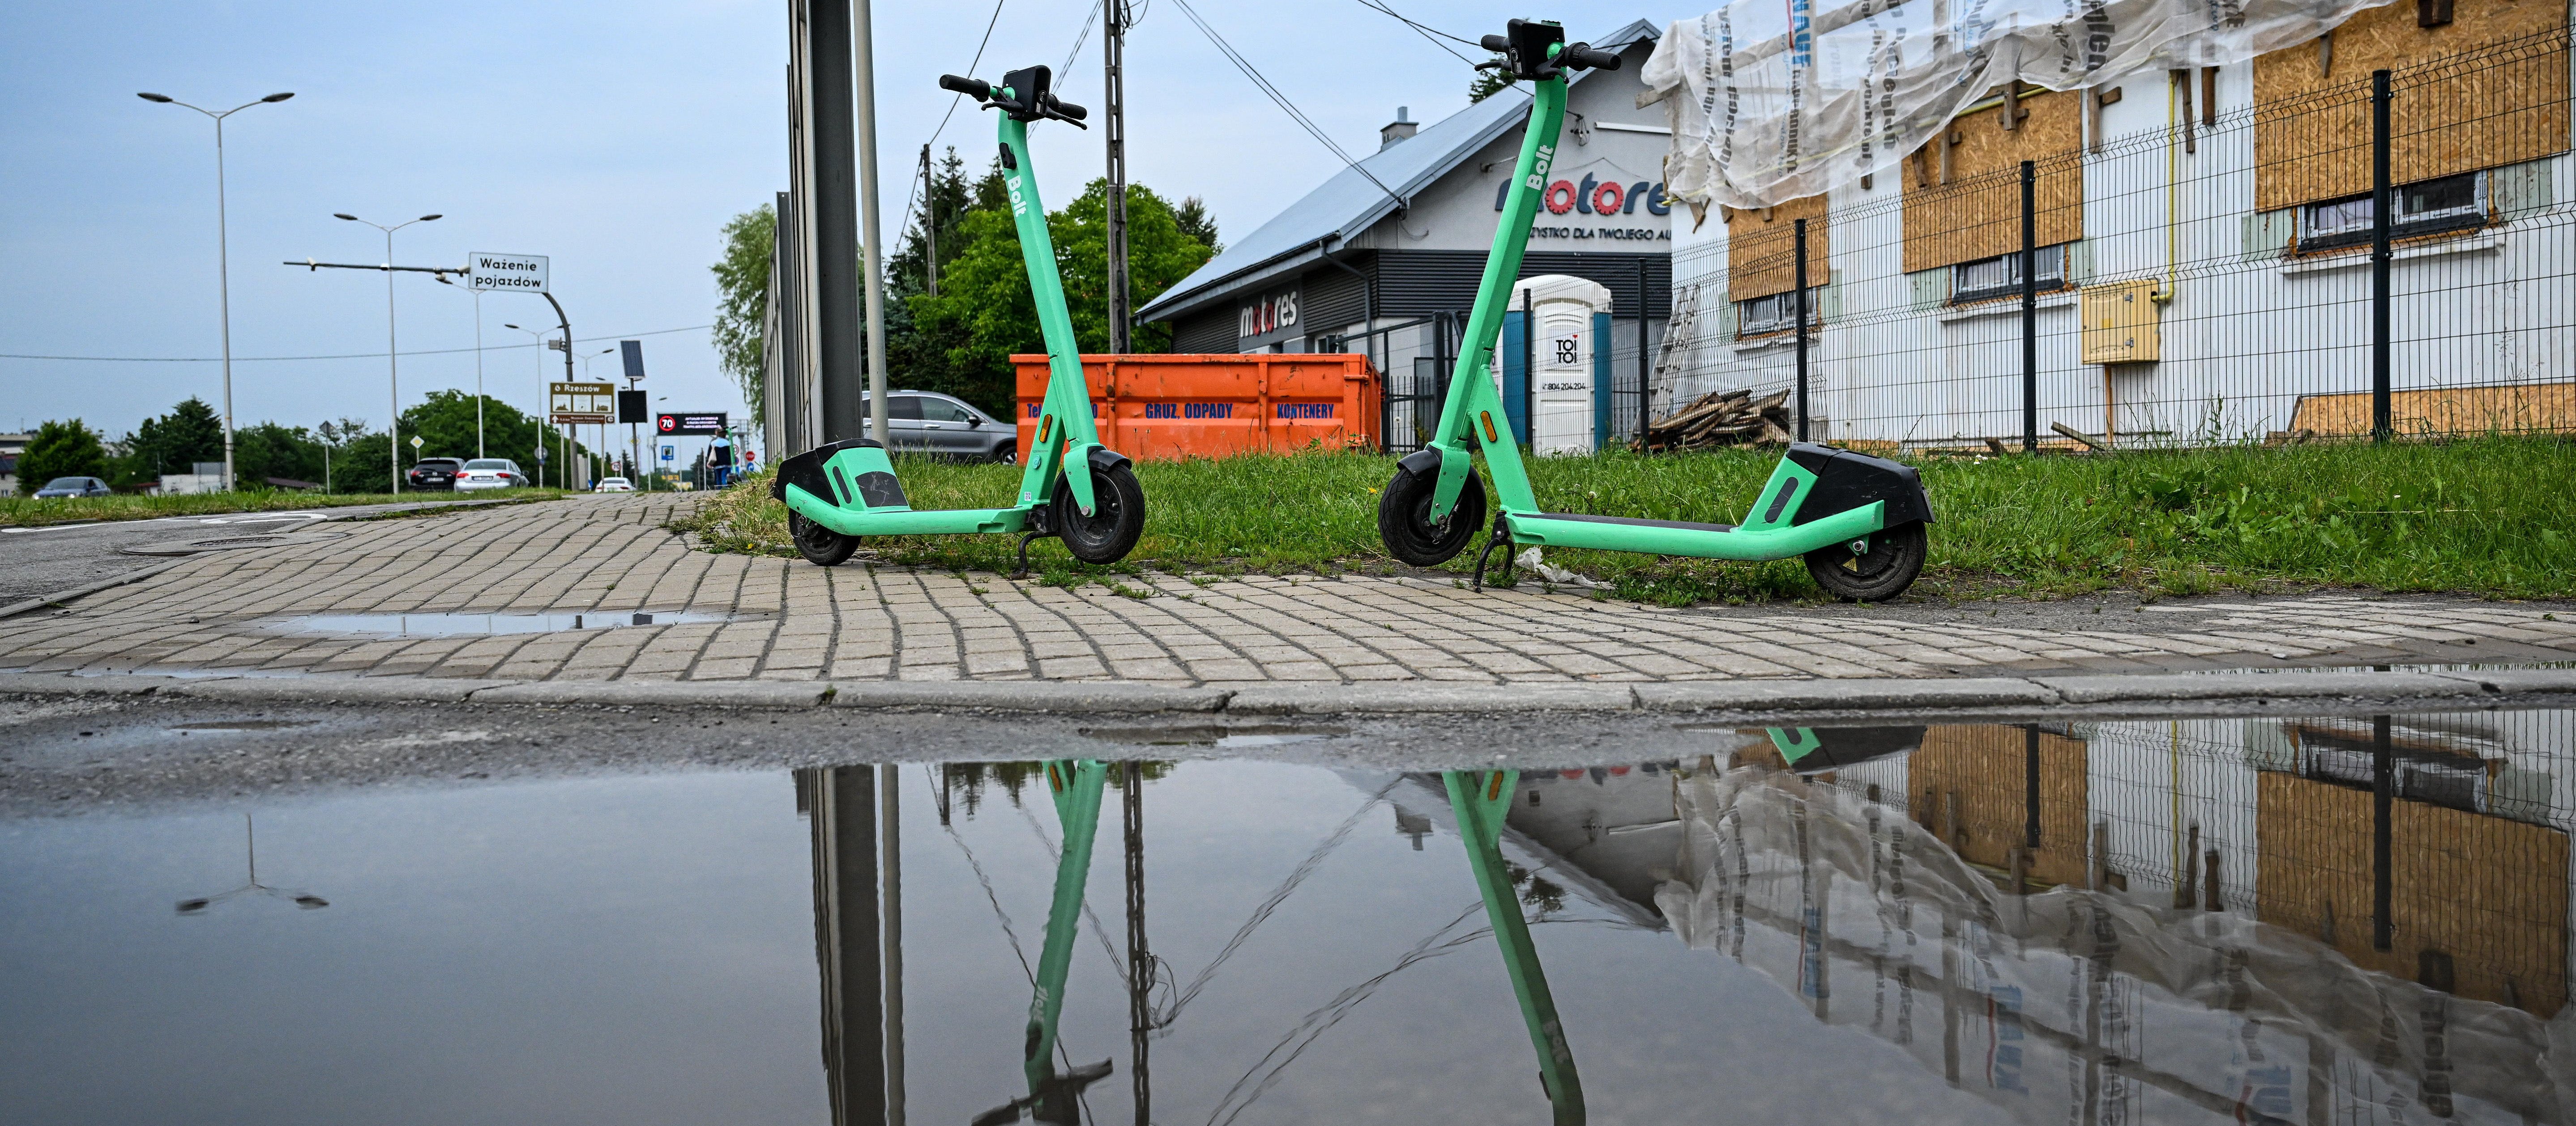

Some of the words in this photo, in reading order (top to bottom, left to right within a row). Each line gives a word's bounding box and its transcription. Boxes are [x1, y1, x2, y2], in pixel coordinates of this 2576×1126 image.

[1525, 145, 1553, 191] Bolt
[1007, 175, 1027, 218] Bolt
[1494, 171, 1670, 215] otore
[1529, 226, 1570, 239] ZYSTKO
[1573, 227, 1595, 239] DLA
[1599, 227, 1654, 240] TWOJEGO
[1656, 228, 1671, 241] AU
[480, 257, 537, 271] Ważenie
[476, 274, 541, 288] pojazdów
[1240, 291, 1297, 337] motores
[1556, 339, 1577, 352] TOI
[1556, 352, 1577, 364] TOI
[564, 384, 600, 392] Rzeszów
[1145, 403, 1181, 420] GRUZ,
[1184, 403, 1233, 419] ODPADY
[1277, 403, 1334, 419] KONTENERY
[662, 419, 673, 428] 70
